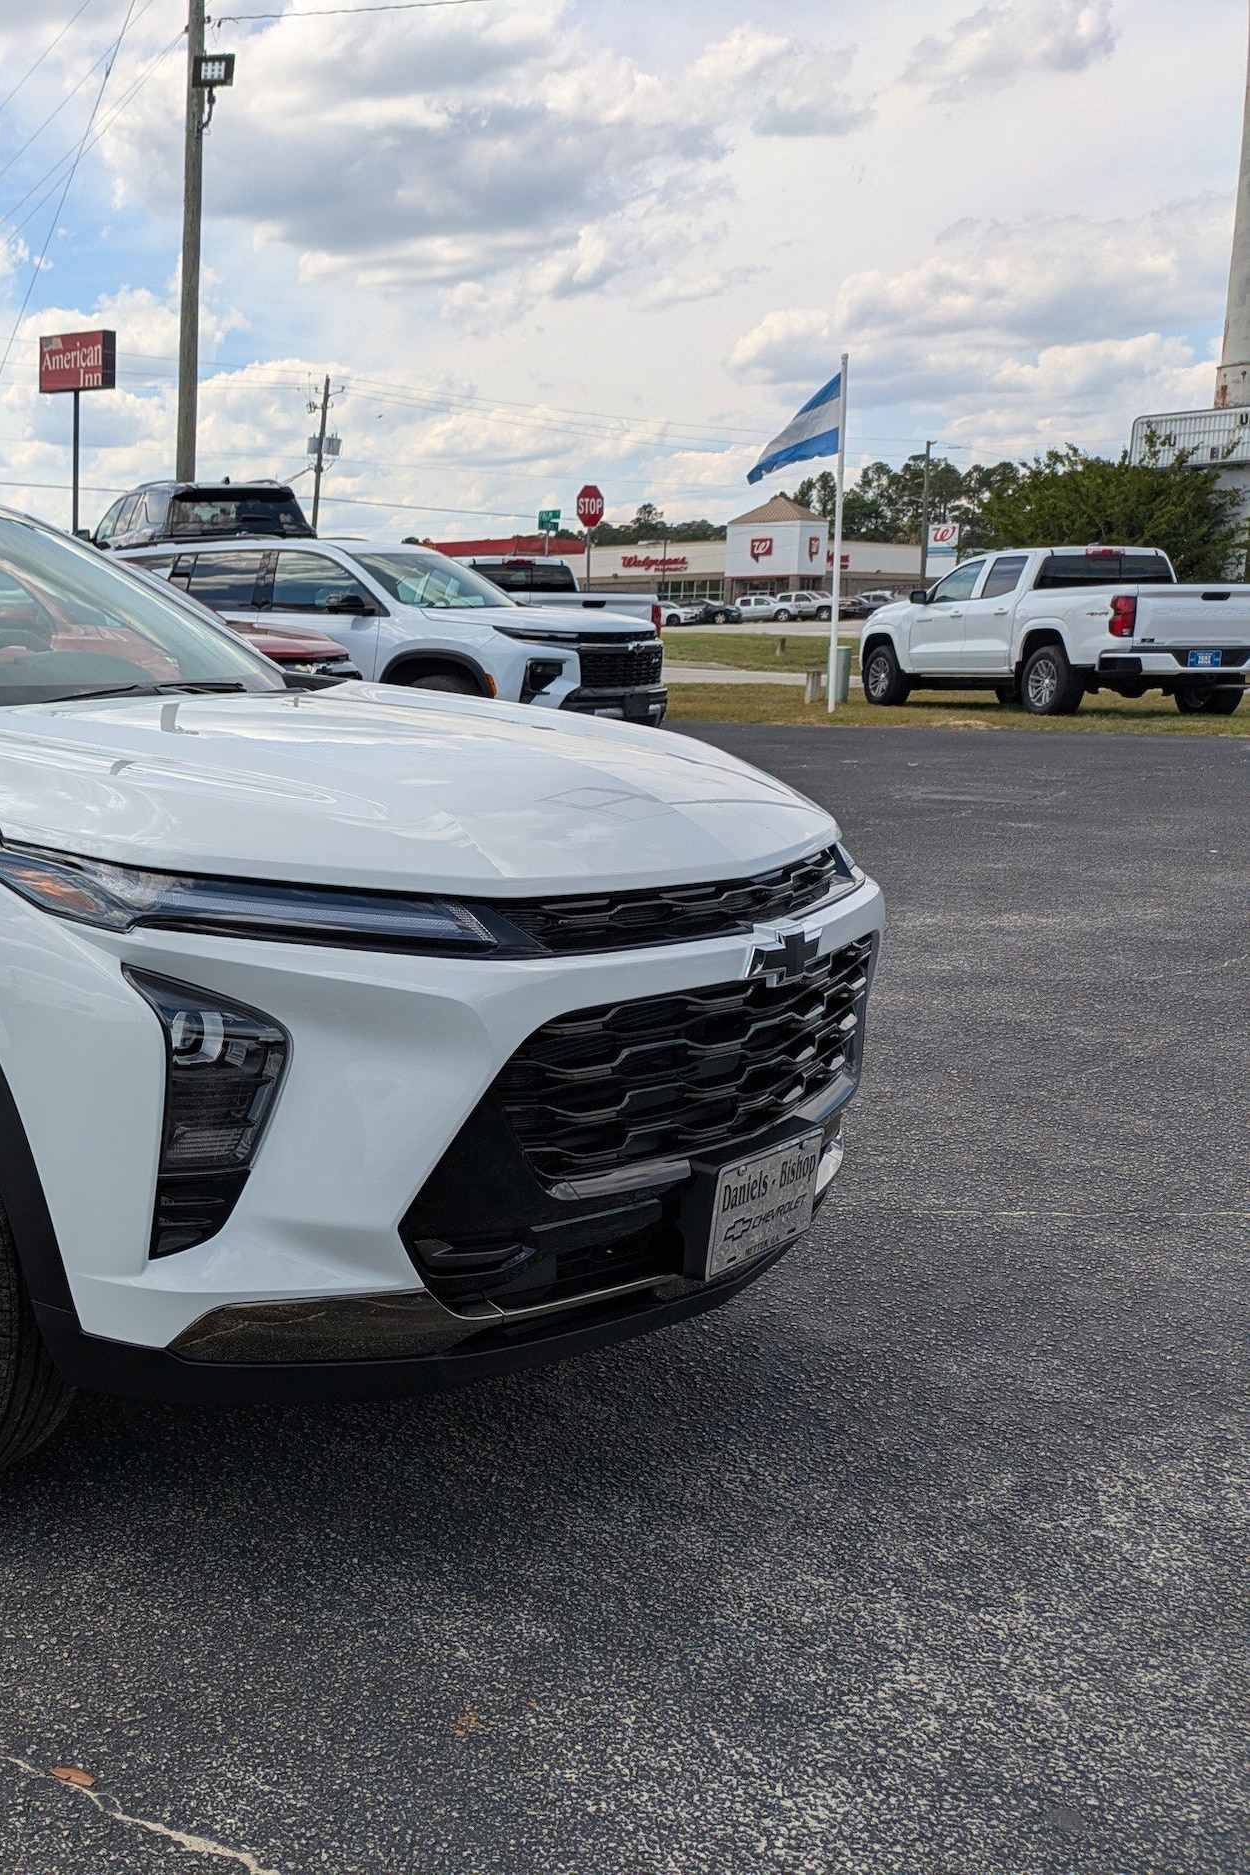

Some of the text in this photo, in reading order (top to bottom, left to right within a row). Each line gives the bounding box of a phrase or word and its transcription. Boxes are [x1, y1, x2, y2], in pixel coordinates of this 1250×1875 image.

[42, 341, 102, 371] American
[79, 368, 102, 387] Inn
[578, 498, 603, 515] STOP
[621, 555, 688, 571] Walgreens
[722, 1170, 769, 1214] Daniels
[779, 1152, 816, 1189] Bishop
[751, 1192, 808, 1230] CHEVROLET
